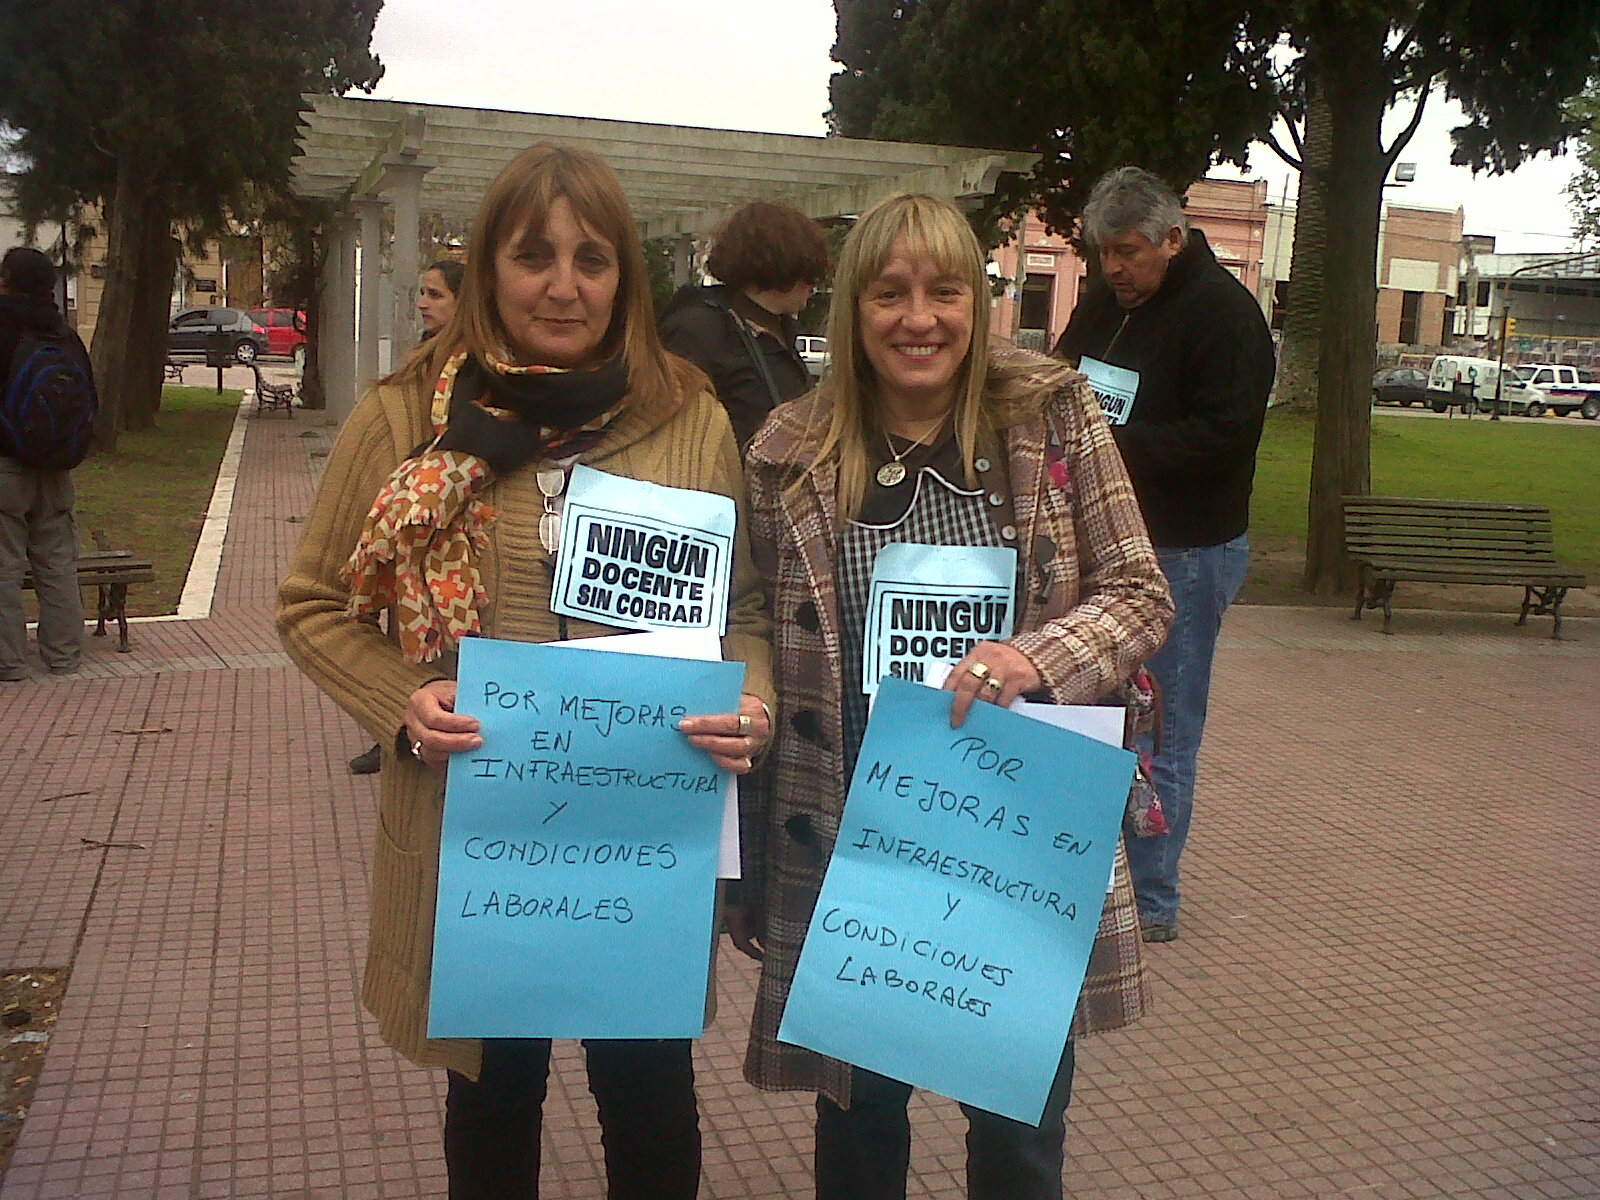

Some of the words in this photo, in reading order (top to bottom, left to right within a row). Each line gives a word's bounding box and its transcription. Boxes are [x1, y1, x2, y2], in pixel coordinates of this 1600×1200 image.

[587, 522, 709, 578] NINGÚN
[582, 557, 704, 601] DOCENTE
[577, 583, 612, 611] SIN
[616, 593, 702, 623] COBRAR
[889, 660, 924, 682] SIN
[484, 682, 540, 714] POR
[560, 696, 688, 737] MEJORAS
[531, 730, 572, 753] EN
[950, 737, 1024, 782] POR
[471, 758, 719, 794] INFRAESTRUCTURA
[542, 801, 568, 825] Y
[866, 760, 1031, 836] MEJORAS
[1053, 832, 1093, 856] EN
[464, 837, 678, 869] CONDICIONES
[852, 828, 1077, 921] INFRAESTRUCTURA
[461, 890, 634, 923] LABORALES
[943, 892, 961, 921] Y
[822, 908, 1014, 986] CONDICIONES
[836, 956, 992, 1018] LABORALES
